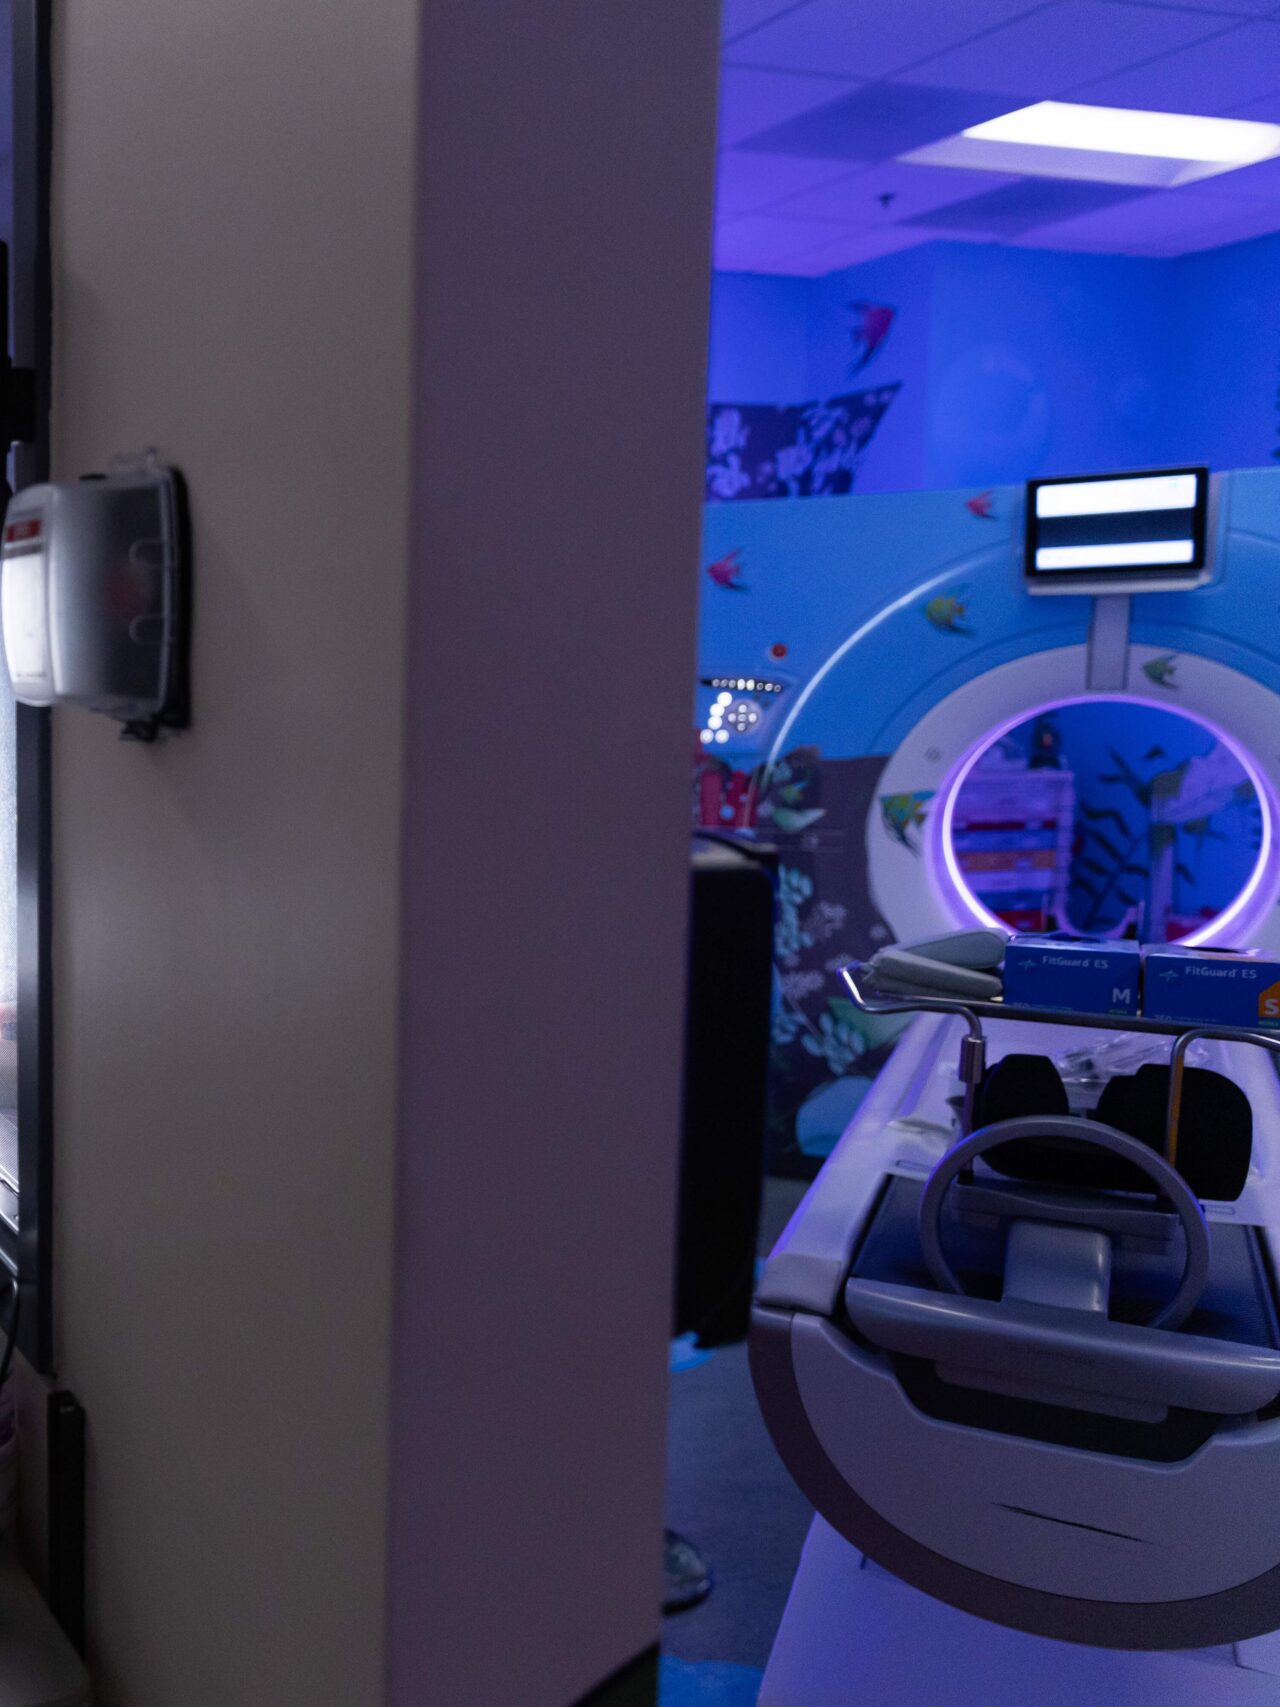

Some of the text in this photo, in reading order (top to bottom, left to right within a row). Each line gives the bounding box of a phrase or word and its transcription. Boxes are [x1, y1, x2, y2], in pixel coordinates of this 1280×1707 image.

[1042, 955, 1109, 969] FitGuard ES
[1185, 966, 1257, 979] FitGuard ES
[1112, 987, 1131, 1004] M
[1263, 998, 1280, 1015] S
